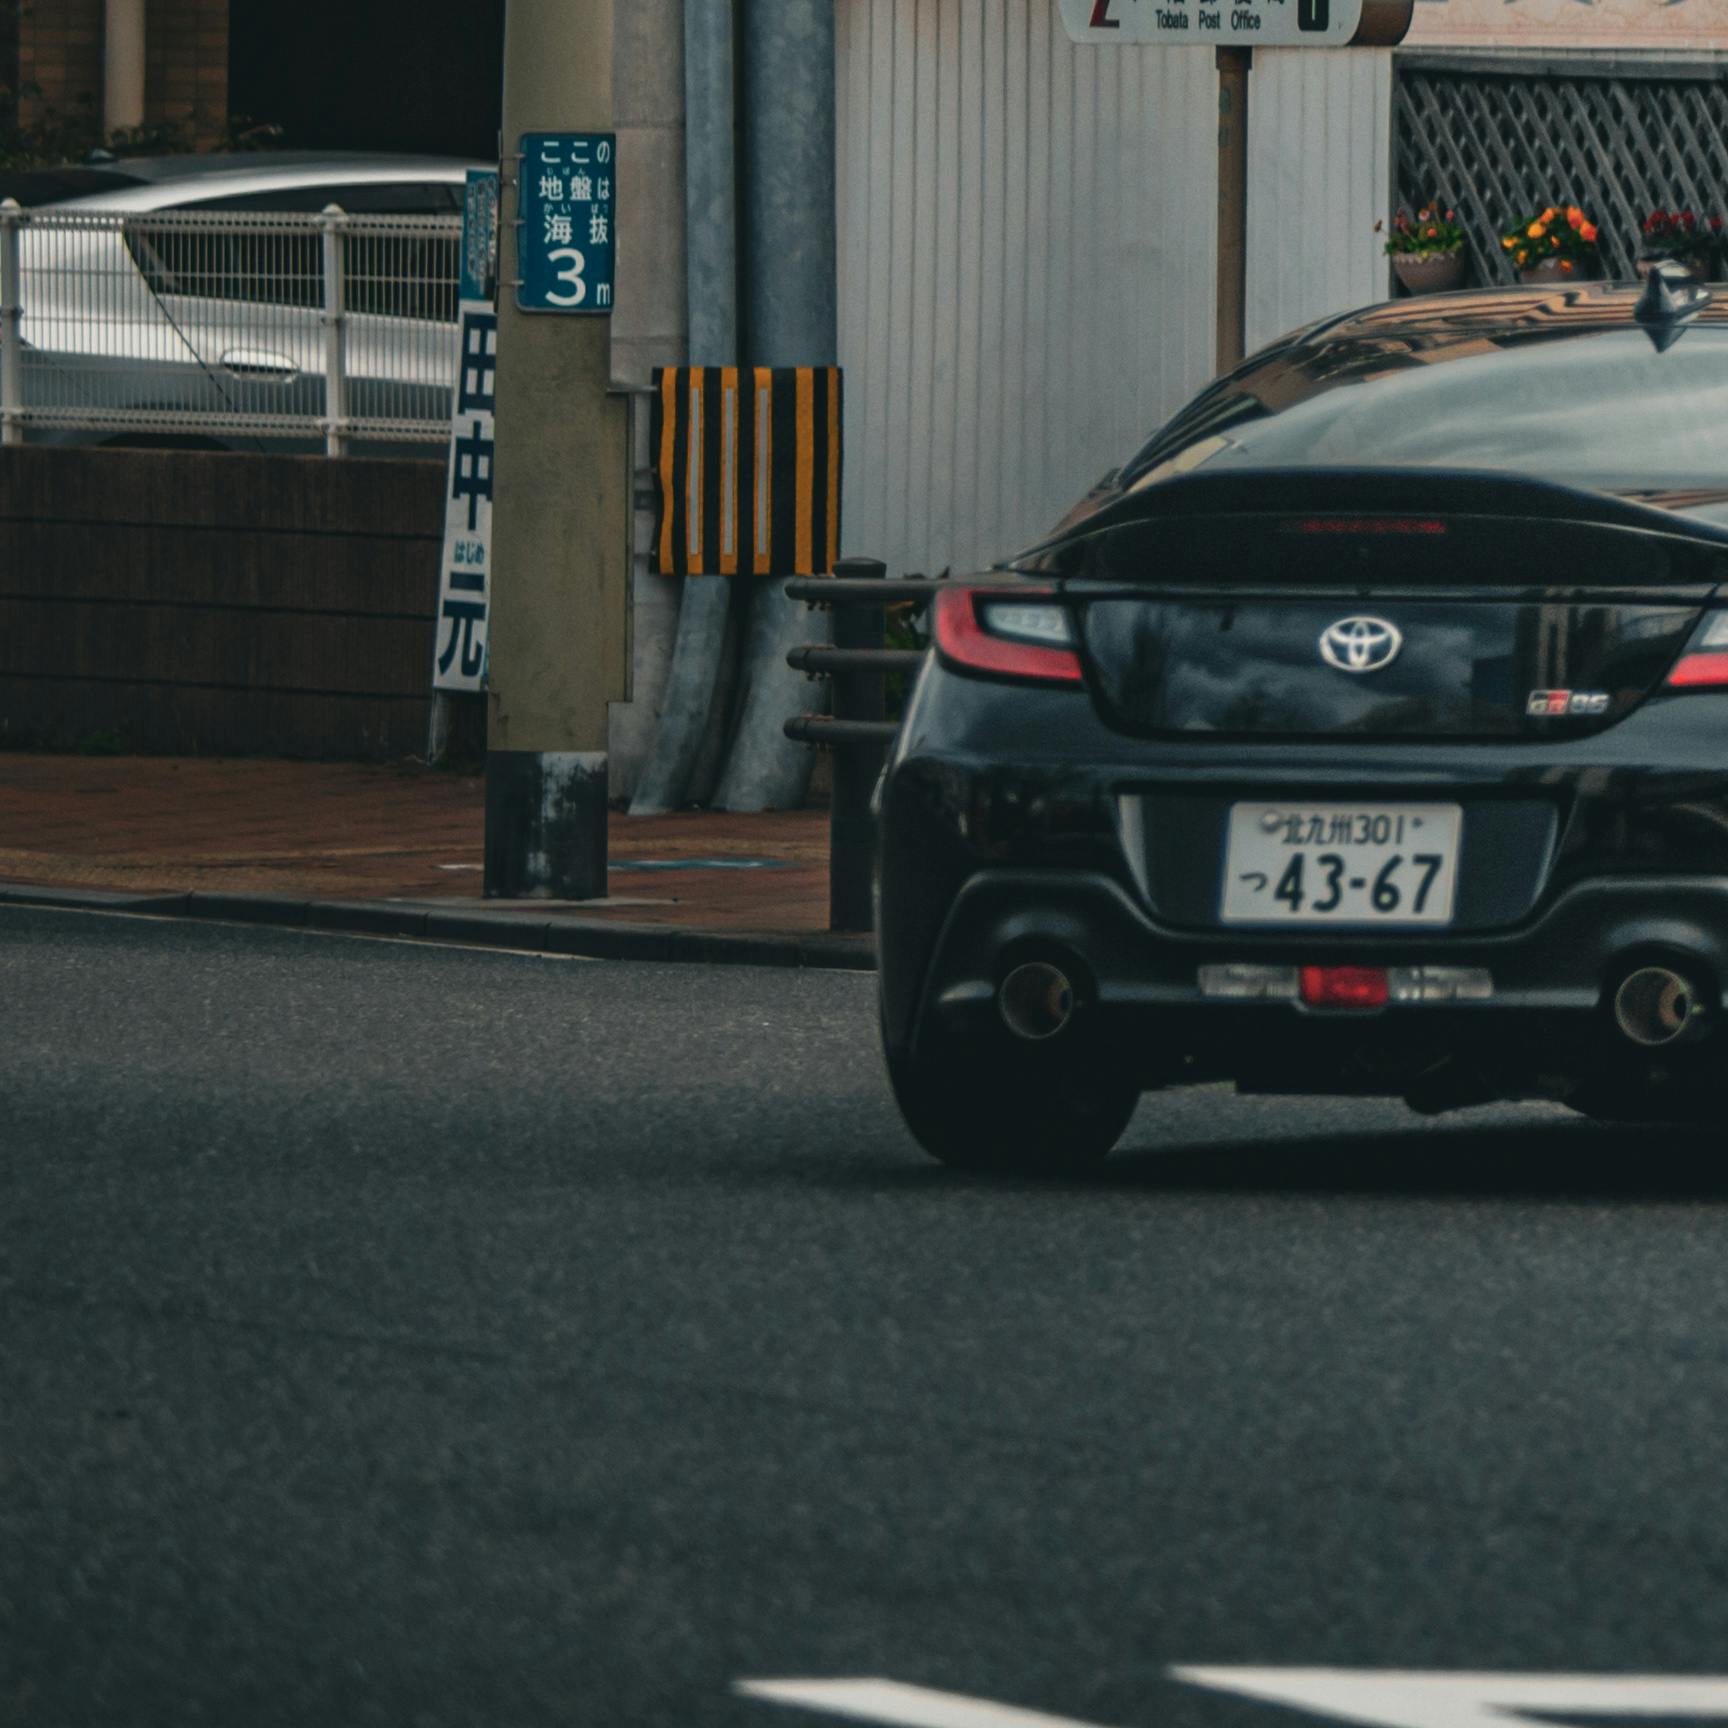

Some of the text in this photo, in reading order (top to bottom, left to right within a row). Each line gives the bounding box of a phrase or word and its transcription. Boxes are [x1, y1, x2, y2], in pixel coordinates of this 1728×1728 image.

[1156, 9, 1261, 30] Tobata Post Office
[541, 141, 611, 164] ここの
[539, 175, 610, 202] 地盤は
[543, 214, 609, 245] 海抜
[1274, 852, 1443, 915] 43-67
